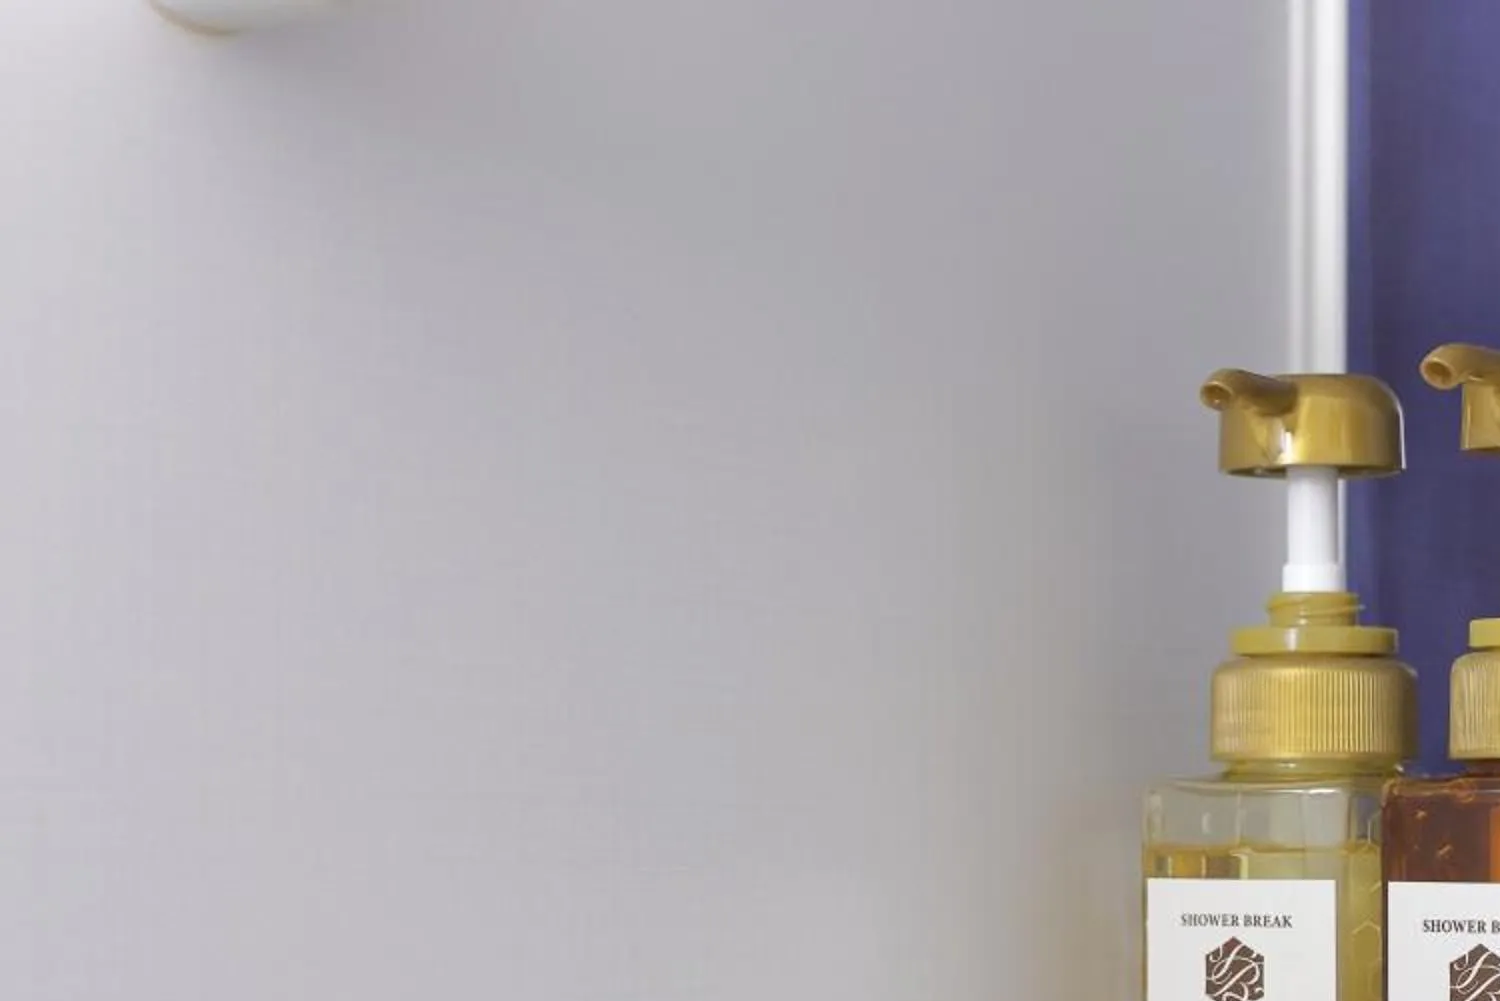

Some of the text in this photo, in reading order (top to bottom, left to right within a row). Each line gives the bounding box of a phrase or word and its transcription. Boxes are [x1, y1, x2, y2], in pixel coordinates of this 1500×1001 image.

[1181, 913, 1293, 929] SHOWER BREAK
[1422, 919, 1487, 934] SHOWER
